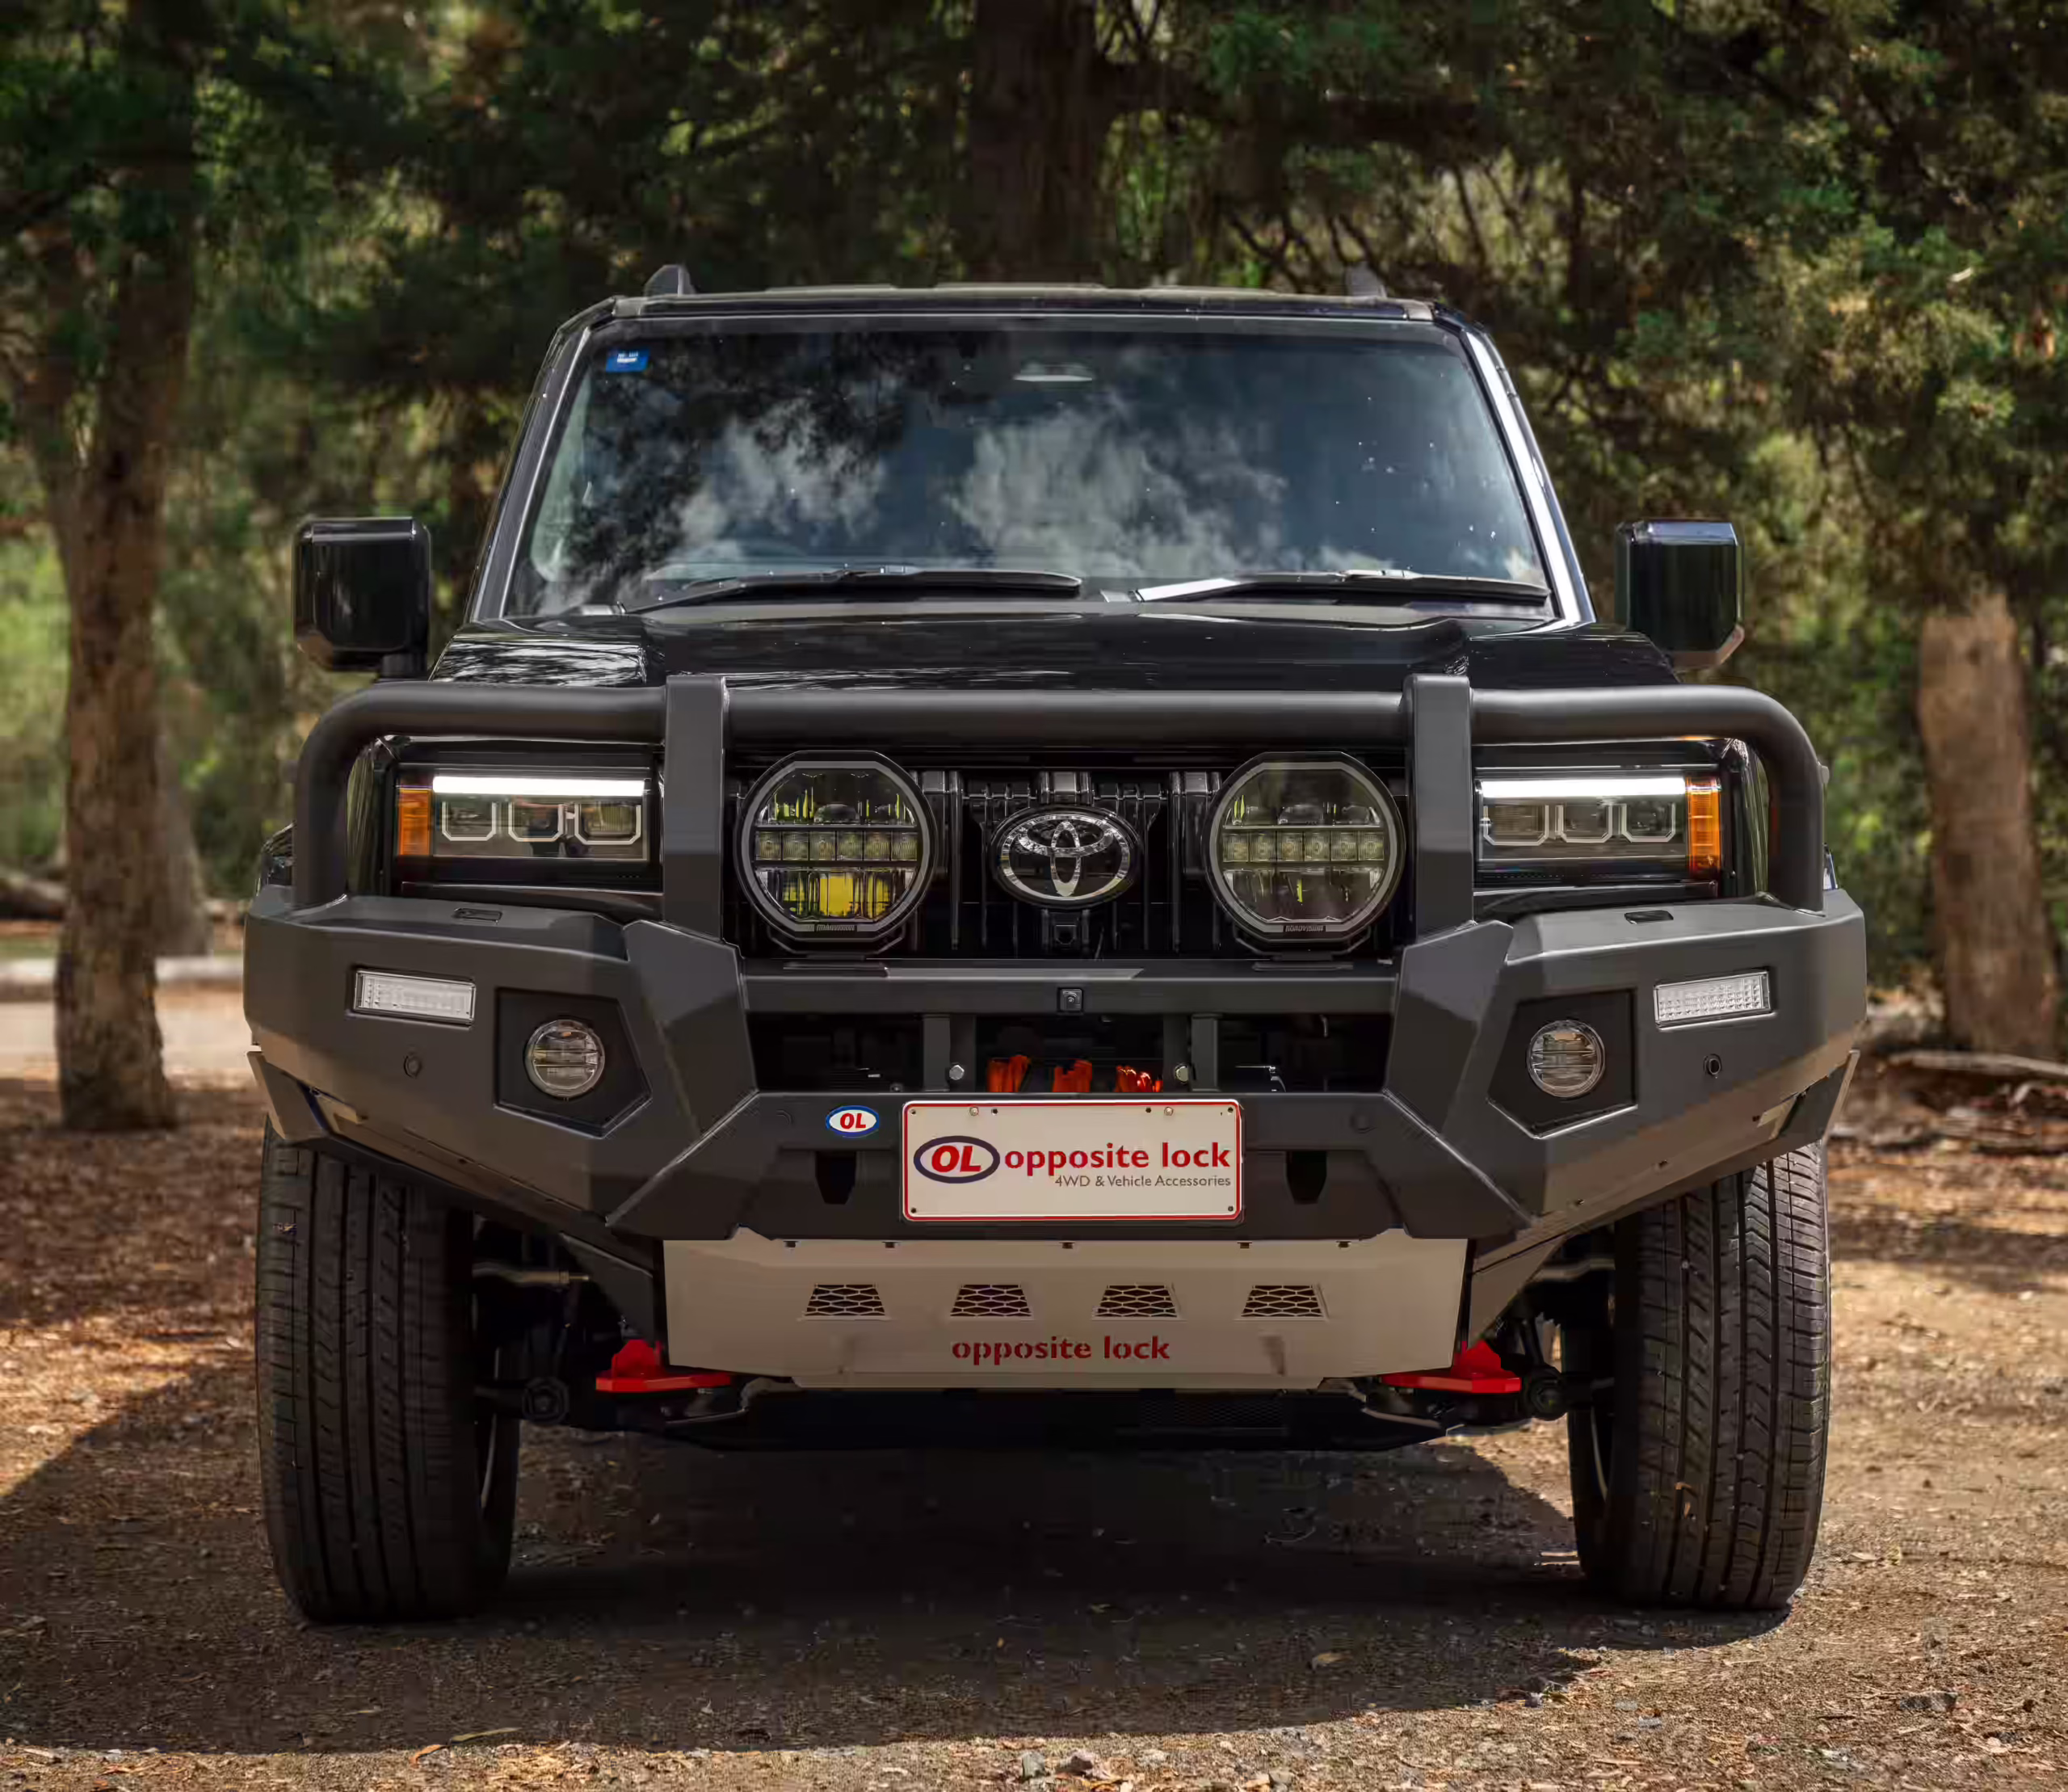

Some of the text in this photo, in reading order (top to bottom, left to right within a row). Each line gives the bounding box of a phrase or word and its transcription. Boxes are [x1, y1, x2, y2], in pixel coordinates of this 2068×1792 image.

[840, 1113, 866, 1129] OL
[931, 1142, 1231, 1177] OL opposite lock
[1055, 1175, 1231, 1188] 4WD & Vehicle Accessories
[952, 1336, 1171, 1366] opposite lock
